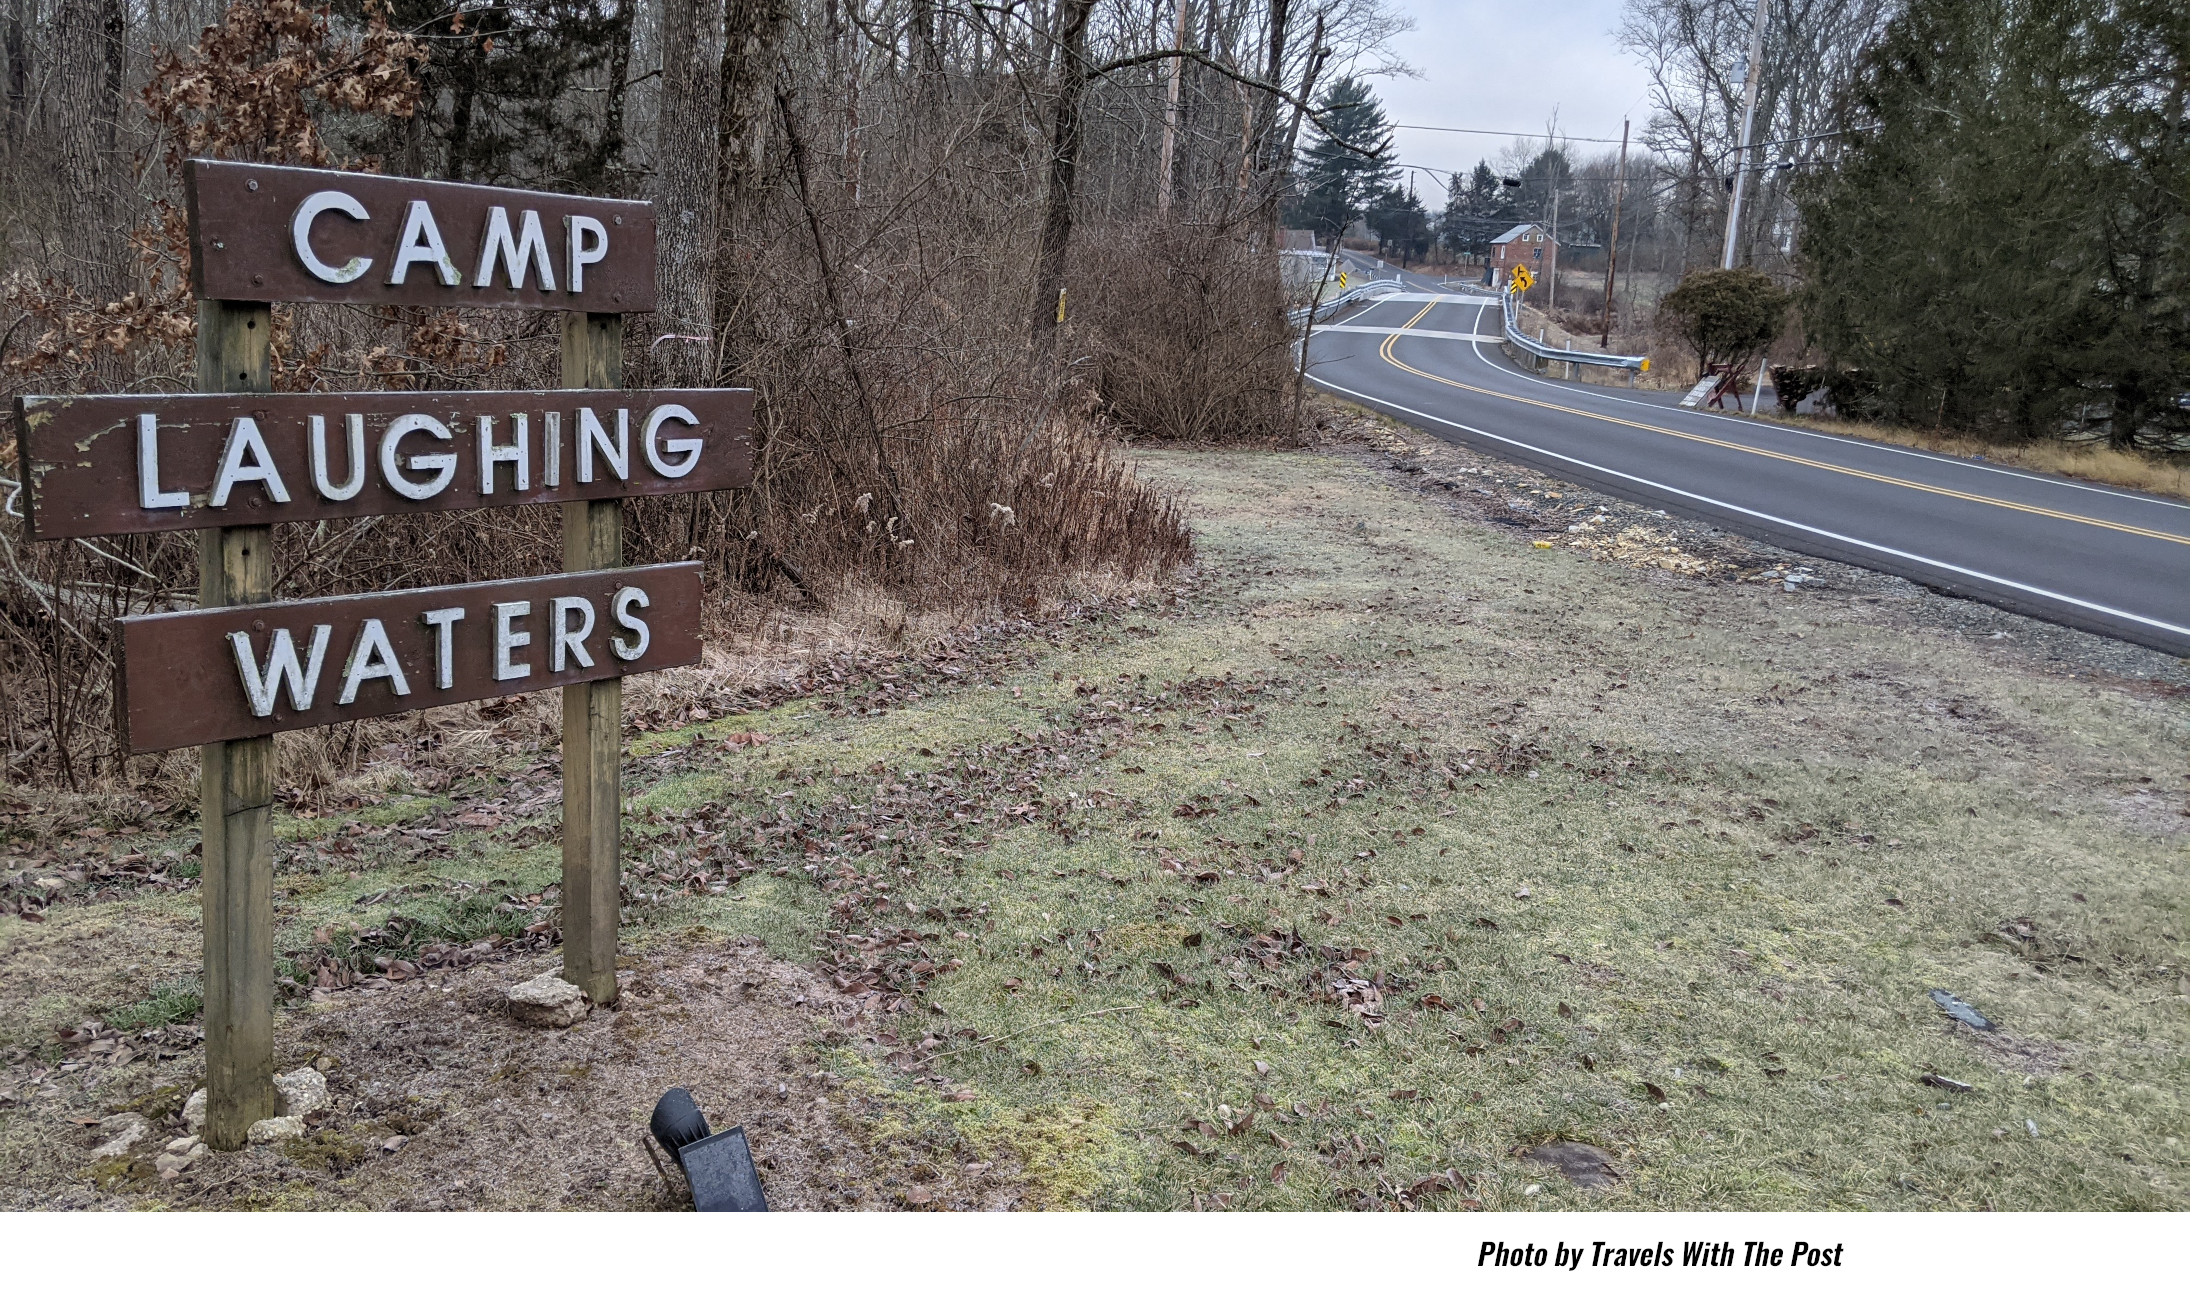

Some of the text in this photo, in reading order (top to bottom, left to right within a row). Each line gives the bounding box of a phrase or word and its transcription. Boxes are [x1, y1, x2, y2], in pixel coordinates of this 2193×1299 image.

[290, 190, 609, 293] CAMP
[137, 403, 703, 509] LAUGHING
[226, 586, 651, 718] WATERS
